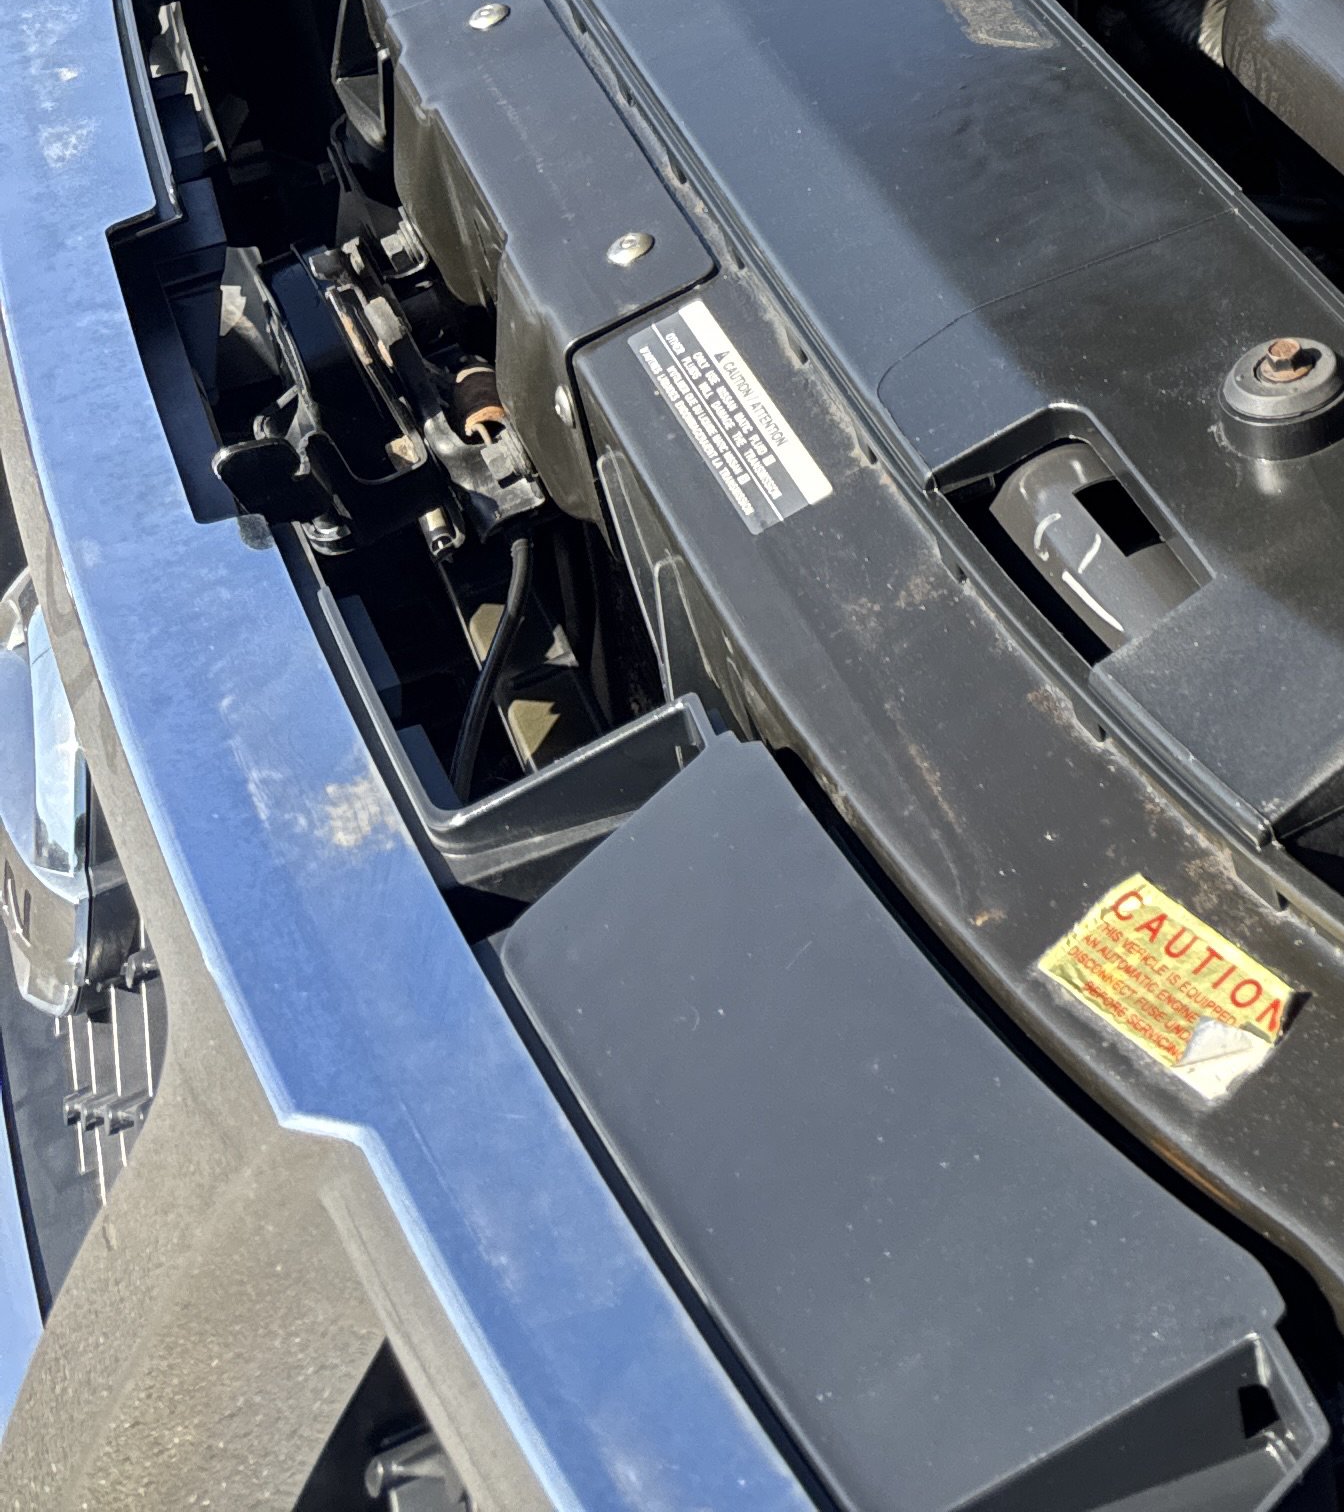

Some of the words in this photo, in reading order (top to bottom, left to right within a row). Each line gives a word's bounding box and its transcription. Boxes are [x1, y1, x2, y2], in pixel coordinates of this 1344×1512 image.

[723, 362, 753, 398] CAUTION
[750, 402, 788, 447] ATTENTION
[1068, 946, 1136, 996] DISCONNECT
[1134, 996, 1168, 1021] FUSE
[1164, 1020, 1192, 1044] UND
[1083, 934, 1100, 949] AN
[1098, 947, 1159, 993] AUTOMATIC
[1157, 990, 1200, 1023] ENGINE
[1083, 981, 1127, 1017] BEFORE
[1098, 922, 1123, 942] THIS
[1122, 939, 1169, 976] VEHICLE
[1167, 971, 1182, 986] IS
[1179, 981, 1237, 1025] EQUIPPED
[1110, 890, 1282, 1032] CAUTION
